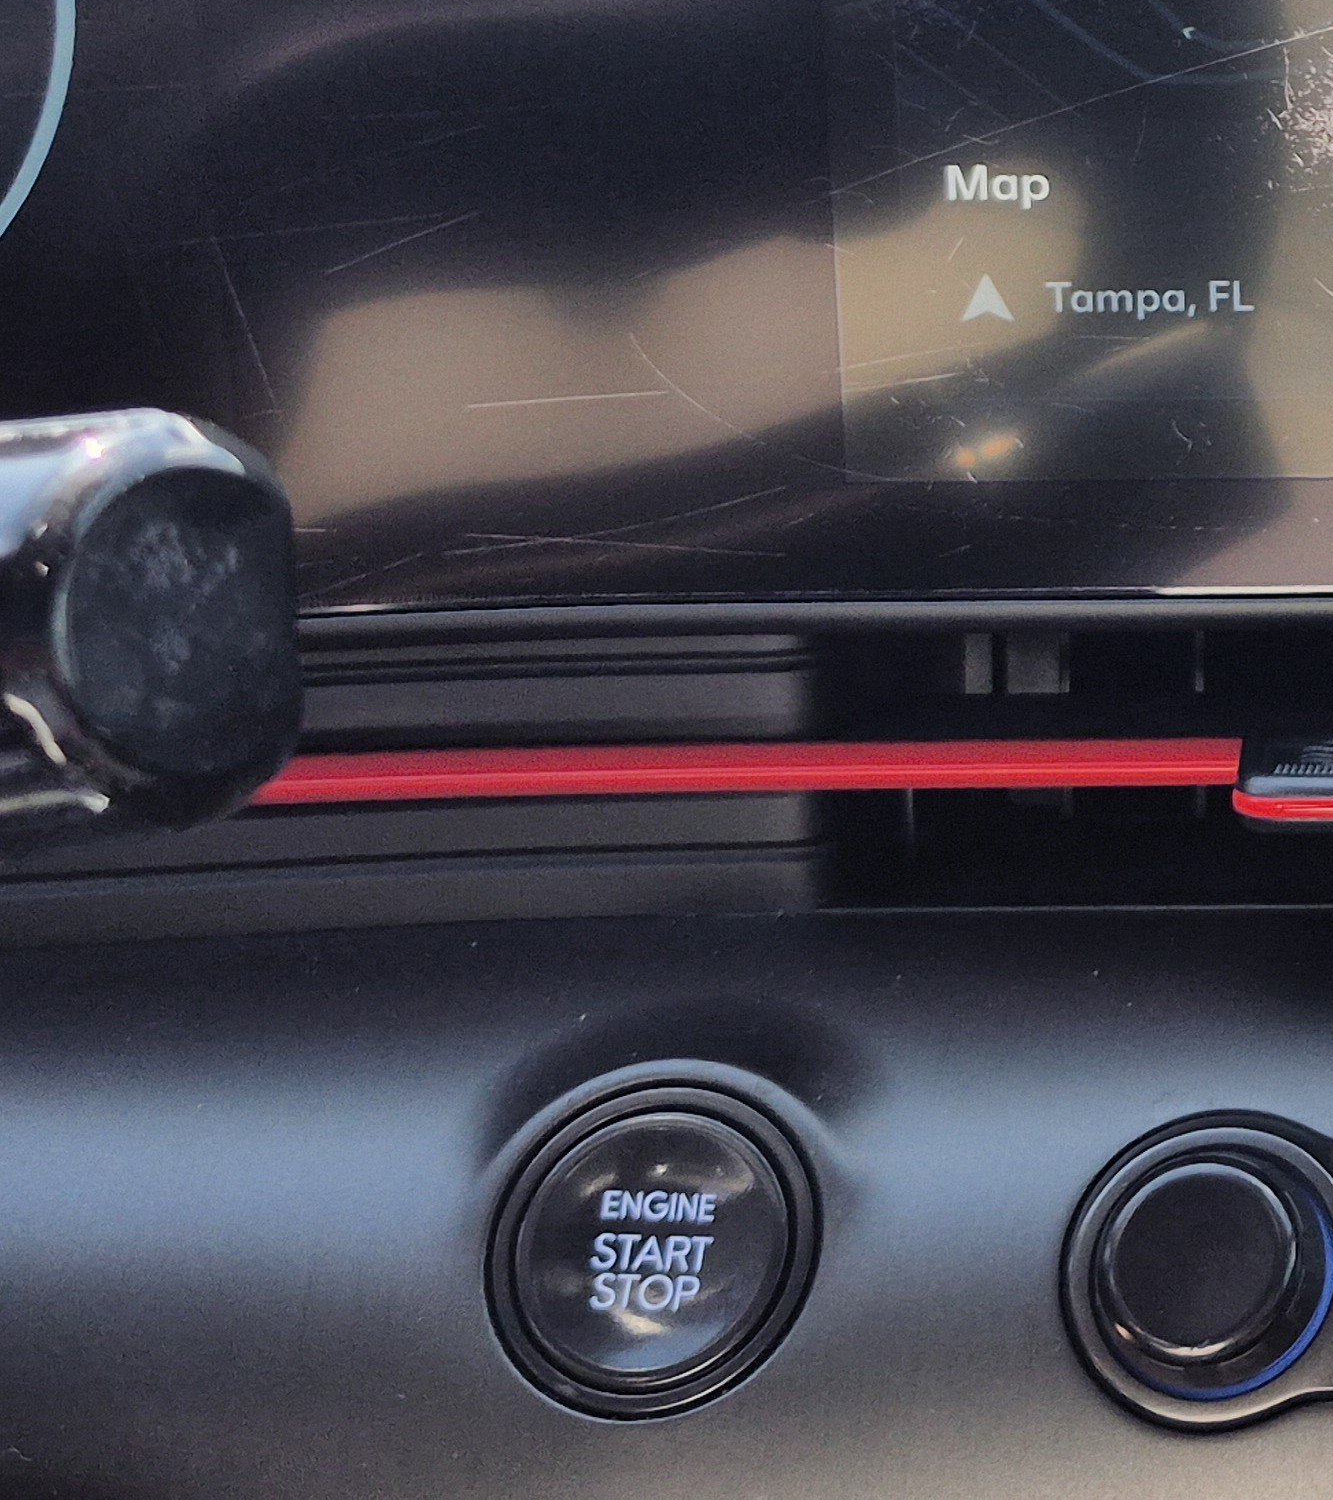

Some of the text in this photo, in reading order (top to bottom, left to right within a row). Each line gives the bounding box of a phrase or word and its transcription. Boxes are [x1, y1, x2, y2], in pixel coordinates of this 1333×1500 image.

[944, 165, 1051, 210] Map
[1046, 280, 1254, 320] Tampa, FL
[601, 1190, 715, 1224] ENGINE
[590, 1234, 713, 1275] START
[590, 1274, 701, 1313] STOP
